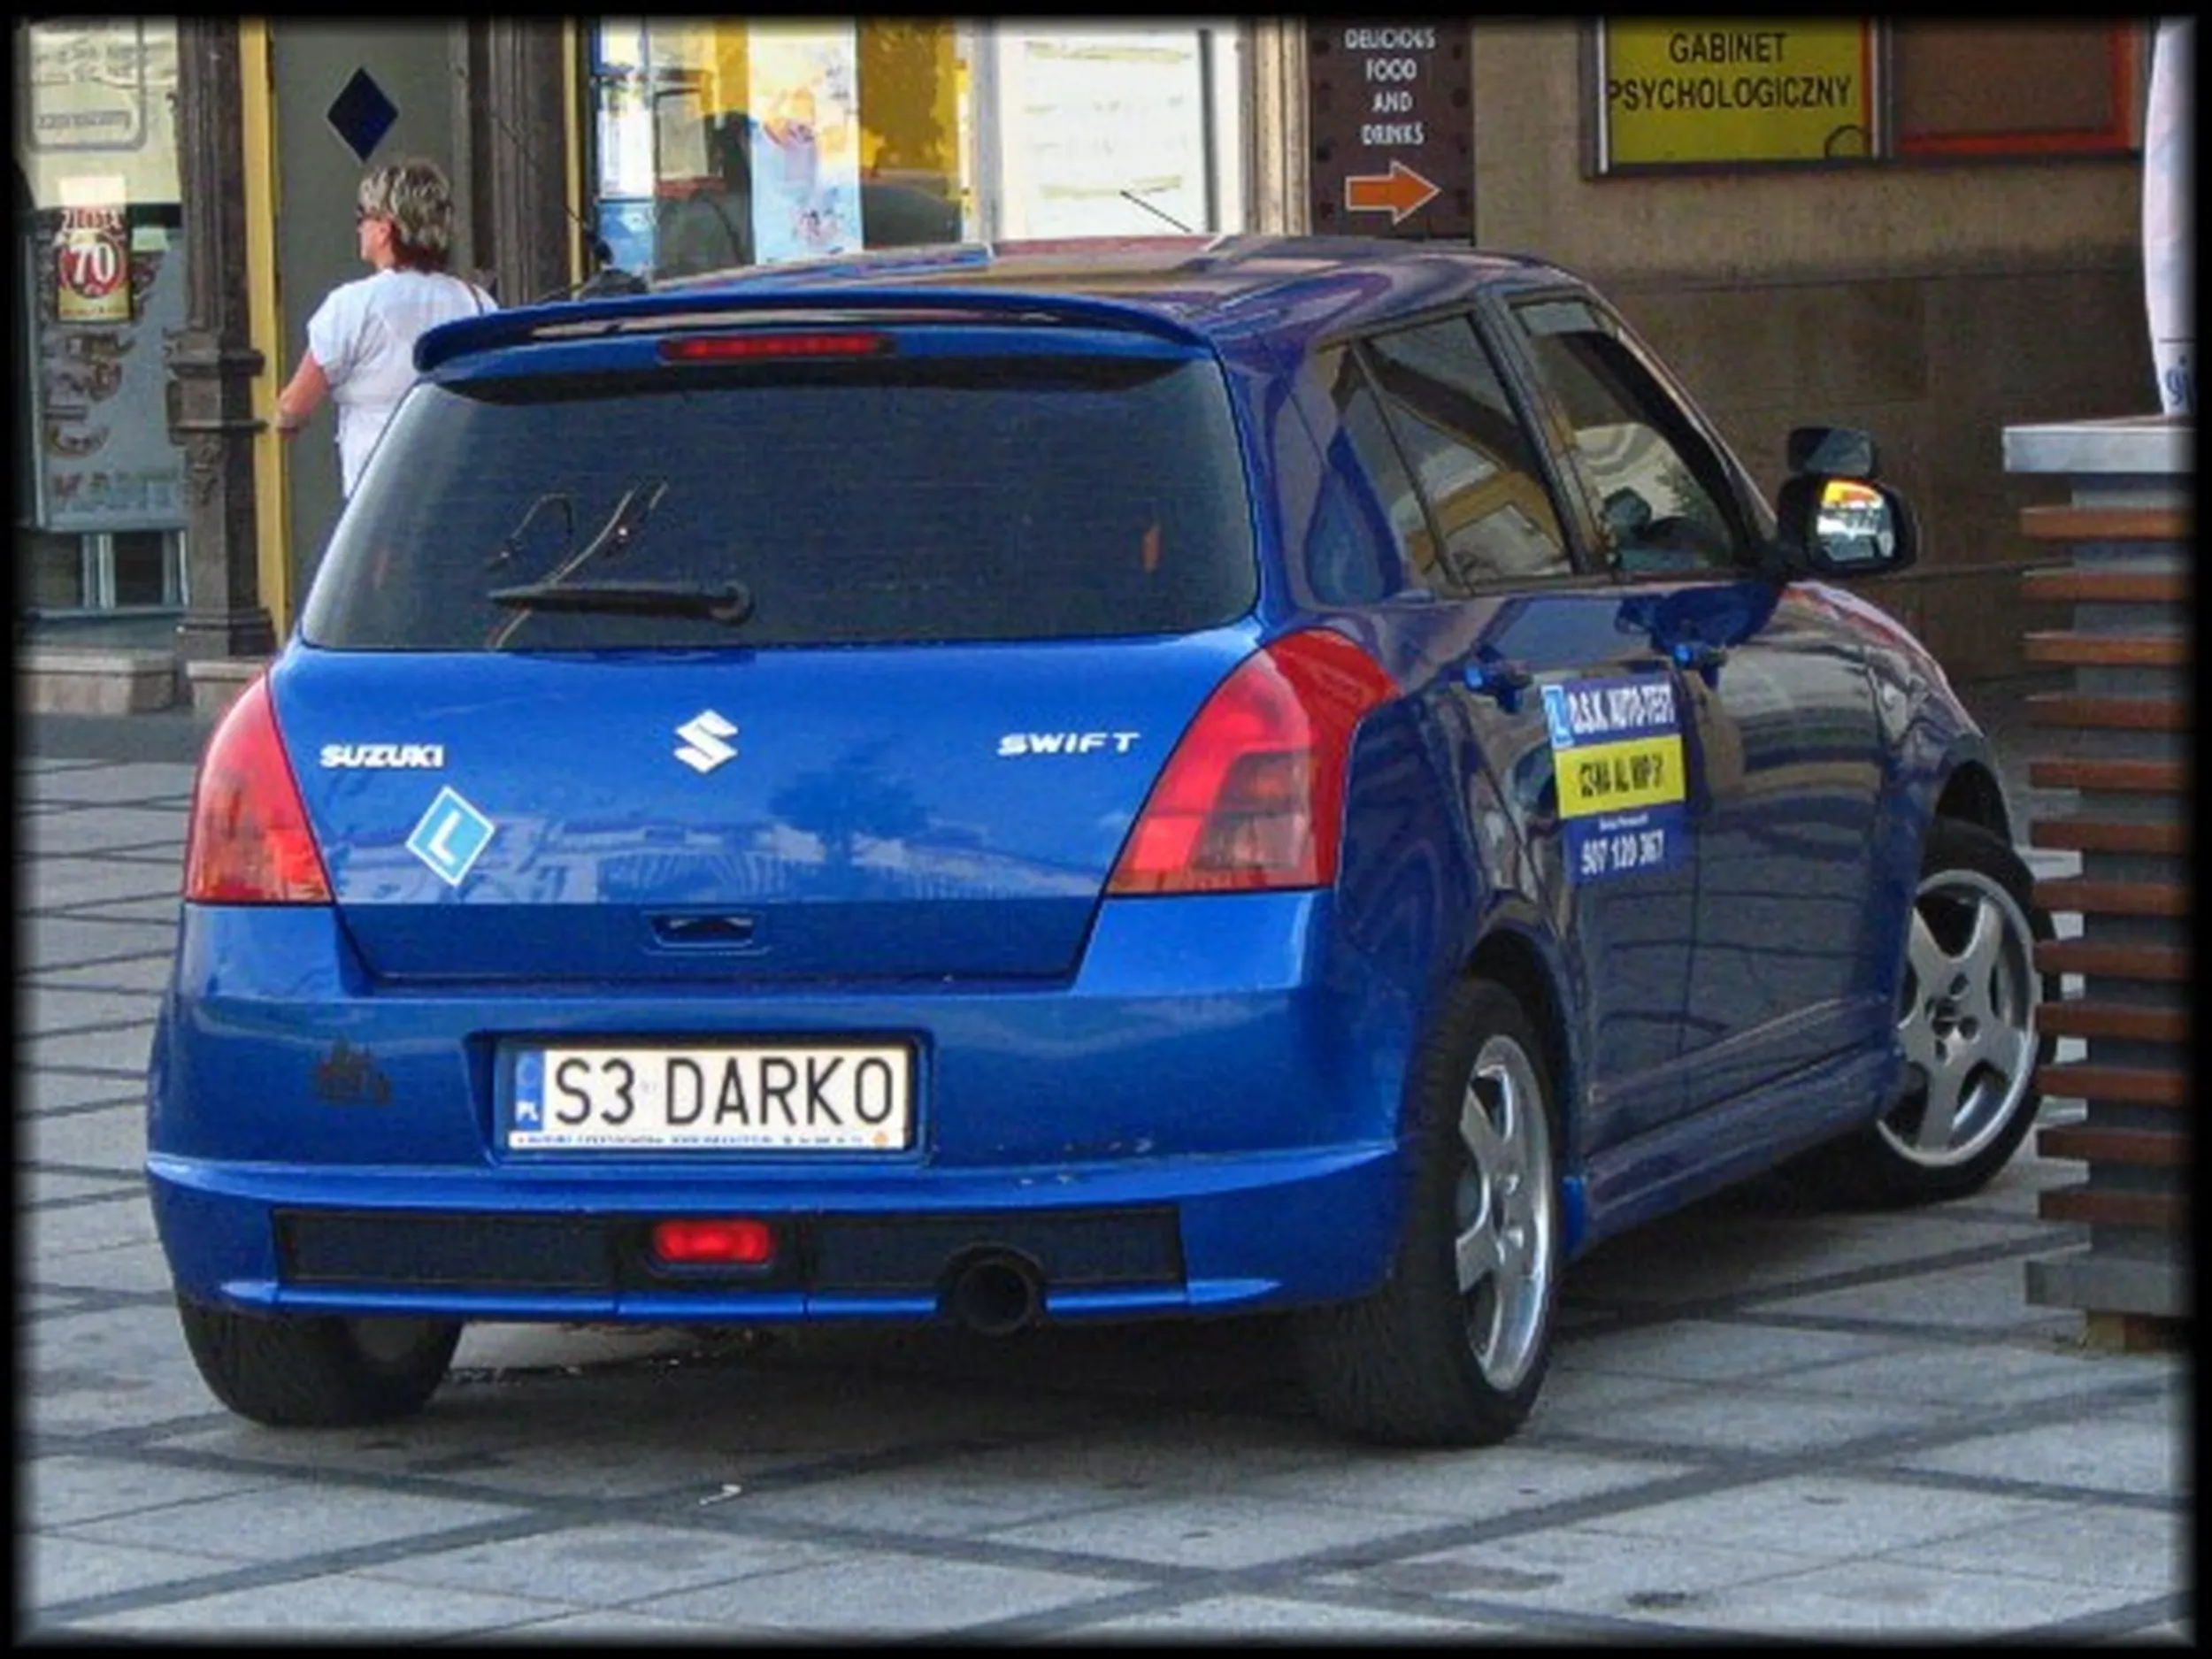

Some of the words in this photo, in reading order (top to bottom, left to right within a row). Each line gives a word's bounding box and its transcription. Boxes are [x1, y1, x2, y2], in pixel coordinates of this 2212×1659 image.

[1345, 27, 1436, 50] DELICIOUS
[1668, 32, 1787, 64] GABINET
[1365, 58, 1417, 82] FOOD
[1372, 90, 1414, 113] AND
[1606, 76, 1852, 110] PSYCHOLOGICZNY
[1361, 120, 1425, 147] DRINKS
[70, 242, 116, 285] 70
[319, 744, 444, 769] SUZUKI
[996, 732, 1141, 757] SWIFT
[427, 809, 462, 866] L
[555, 1056, 635, 1126] S3
[664, 1056, 894, 1126] DARKO
